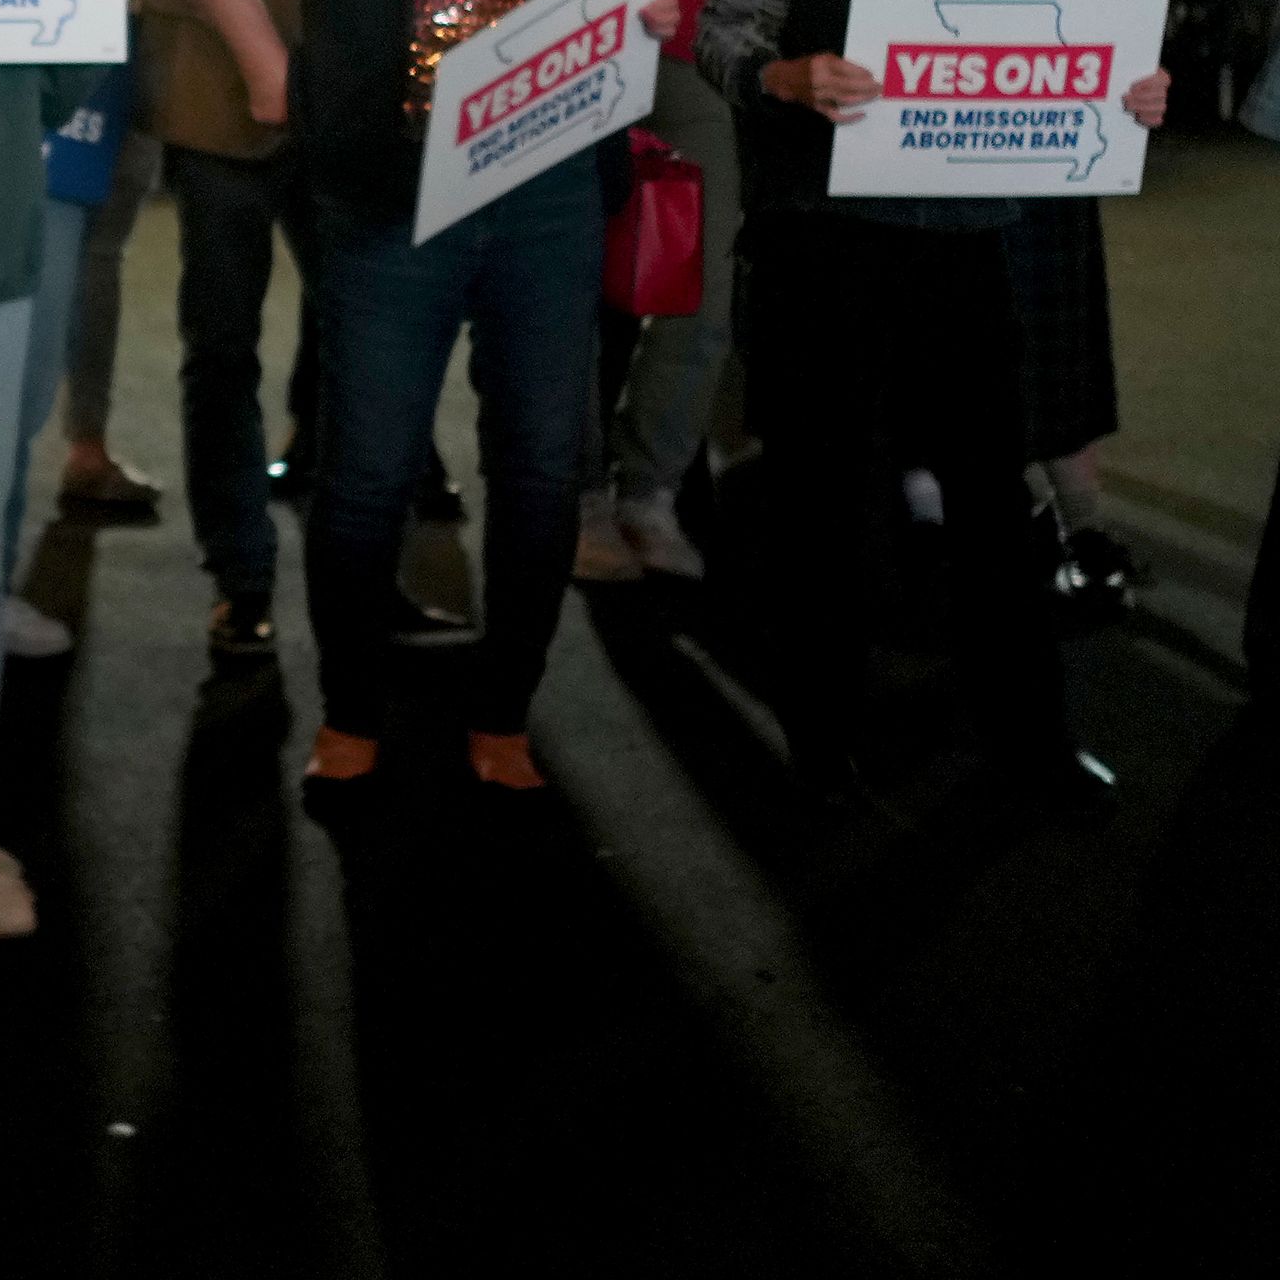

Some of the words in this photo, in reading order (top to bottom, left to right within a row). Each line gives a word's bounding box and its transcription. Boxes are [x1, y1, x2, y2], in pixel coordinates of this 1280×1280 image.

[466, 70, 532, 131] YES
[536, 31, 592, 87] ON
[896, 52, 987, 95] YES
[994, 53, 1070, 96] ON
[1072, 51, 1101, 95] 3
[900, 108, 946, 128] END
[953, 108, 1085, 128] MISSOURI'S
[901, 131, 1025, 150] ABORTION
[1031, 131, 1079, 150] BAN
